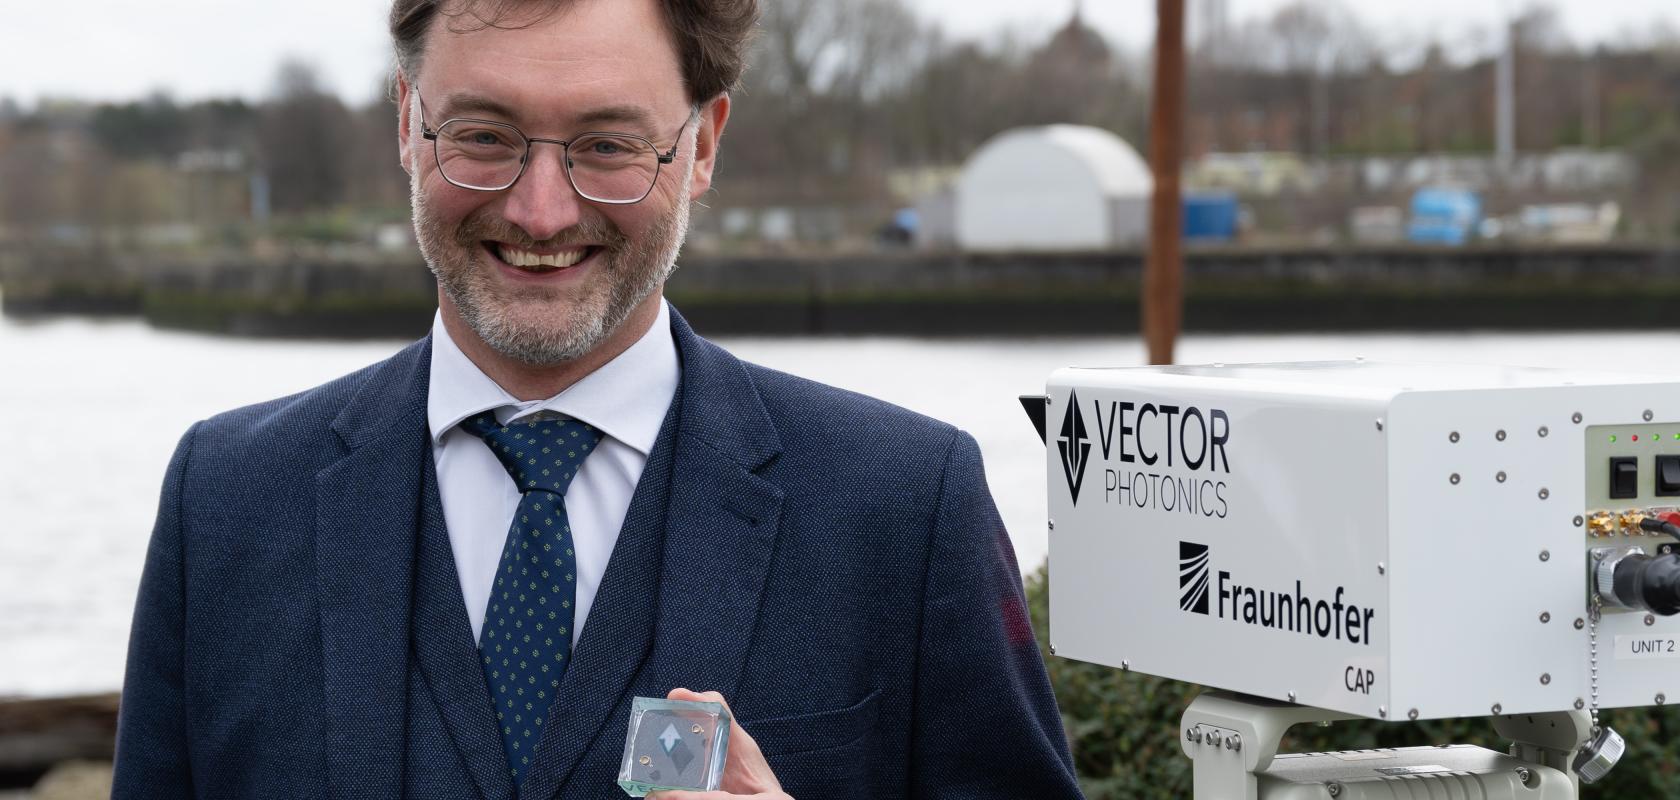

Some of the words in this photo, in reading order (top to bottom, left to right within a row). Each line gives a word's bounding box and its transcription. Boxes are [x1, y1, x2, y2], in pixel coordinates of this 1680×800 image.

[1095, 399, 1230, 473] VECTOR
[1105, 468, 1228, 518] PHOTONICS
[1218, 570, 1374, 645] Fraunhofer
[1632, 640, 1662, 653] UNIT
[1667, 640, 1675, 652] 2
[1344, 665, 1375, 694] CAP
